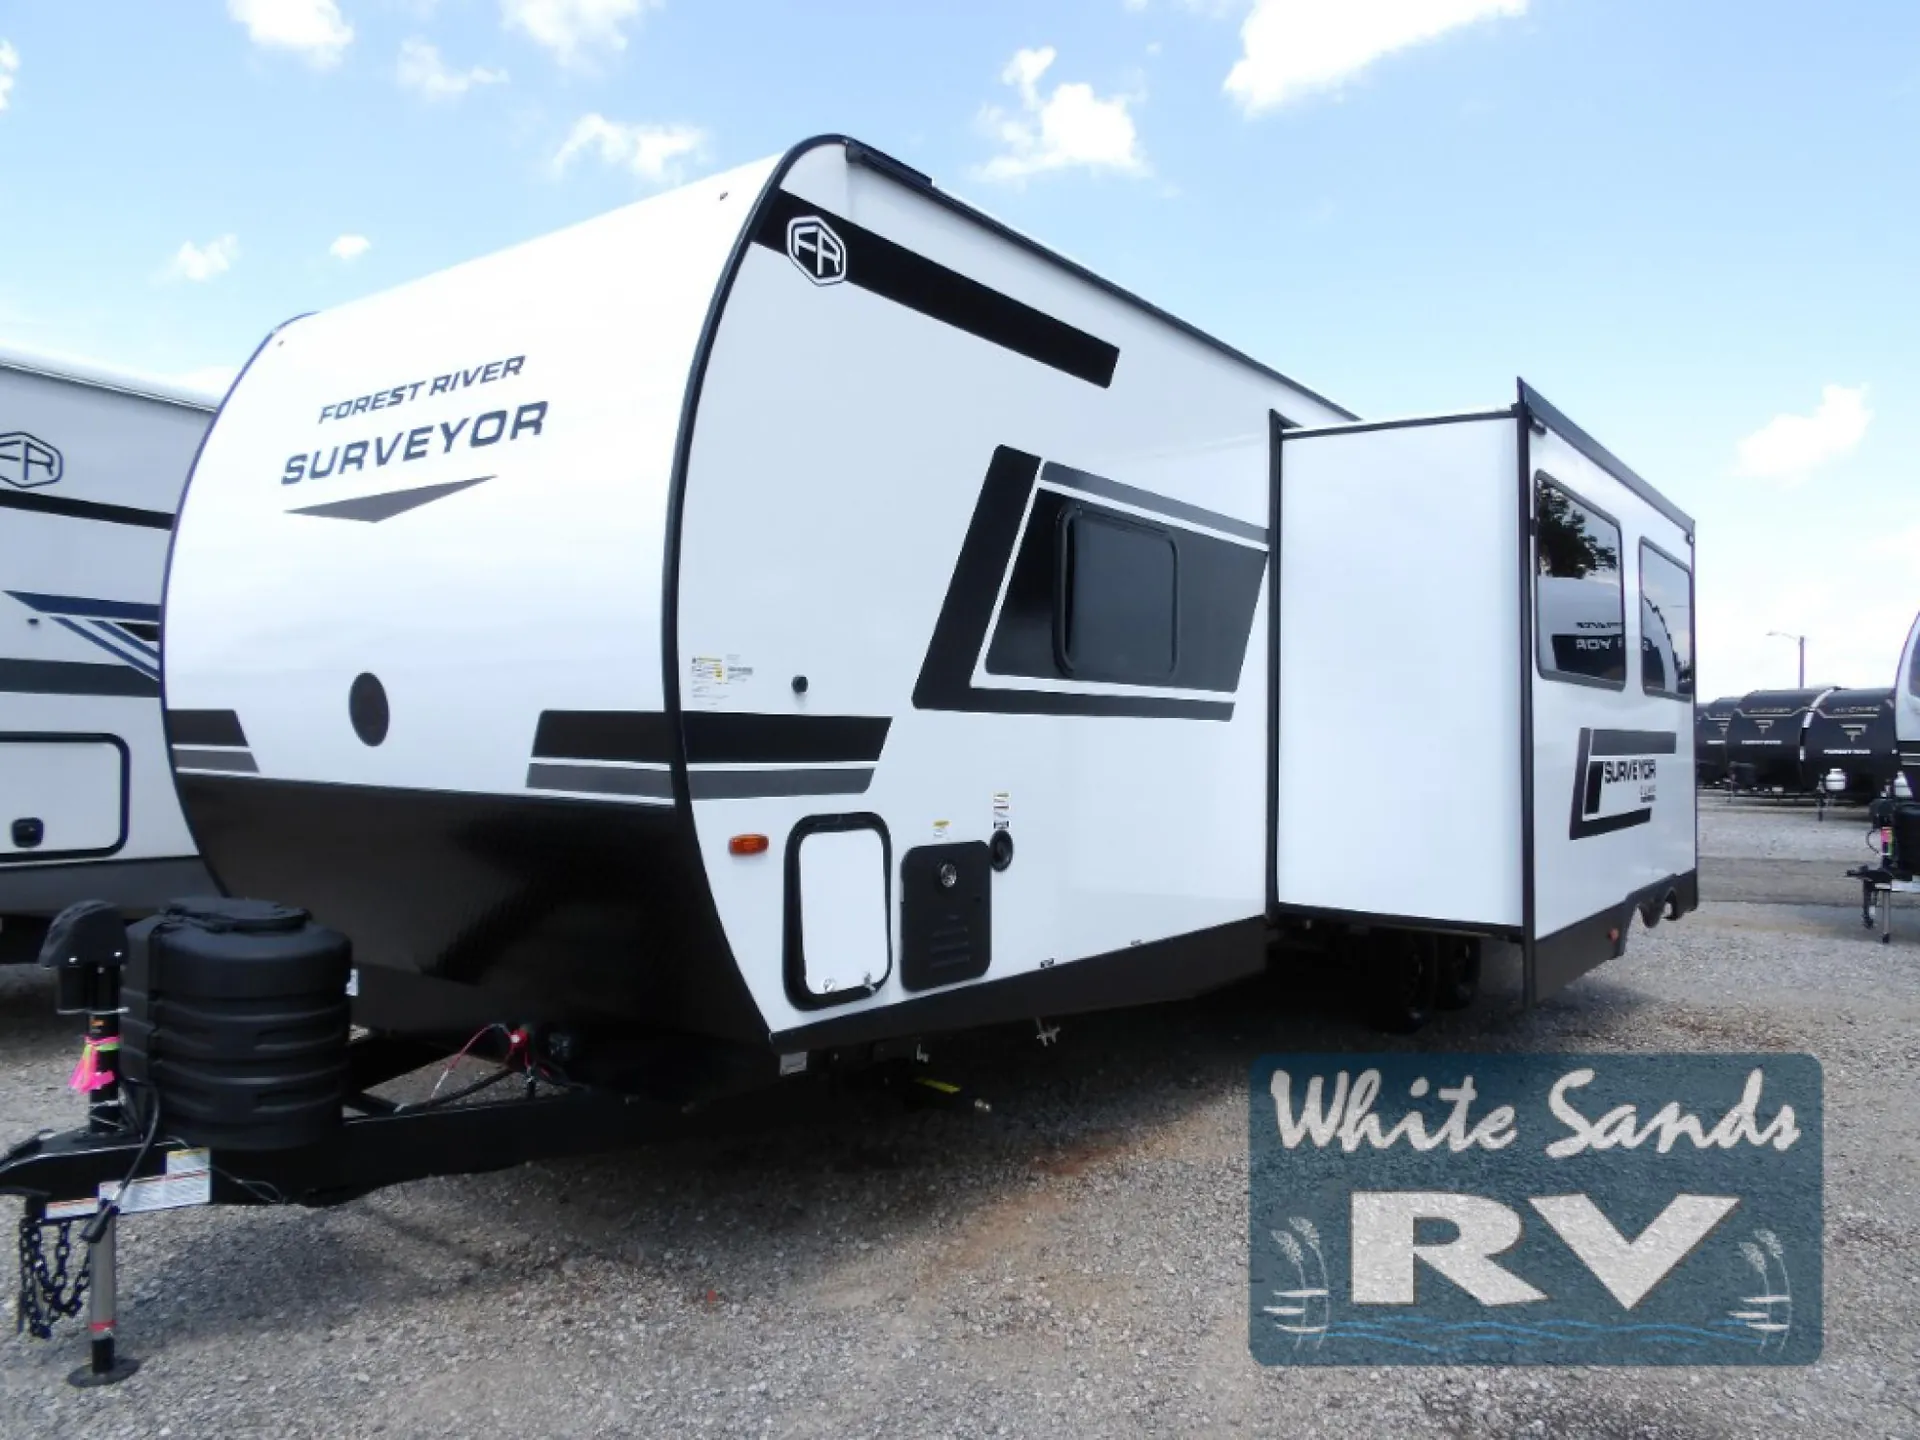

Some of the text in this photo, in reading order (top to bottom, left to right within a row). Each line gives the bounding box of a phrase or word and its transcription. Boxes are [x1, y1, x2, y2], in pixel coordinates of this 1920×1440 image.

[317, 354, 527, 425] FOREST RIVER
[280, 400, 549, 486] SURVEYOR
